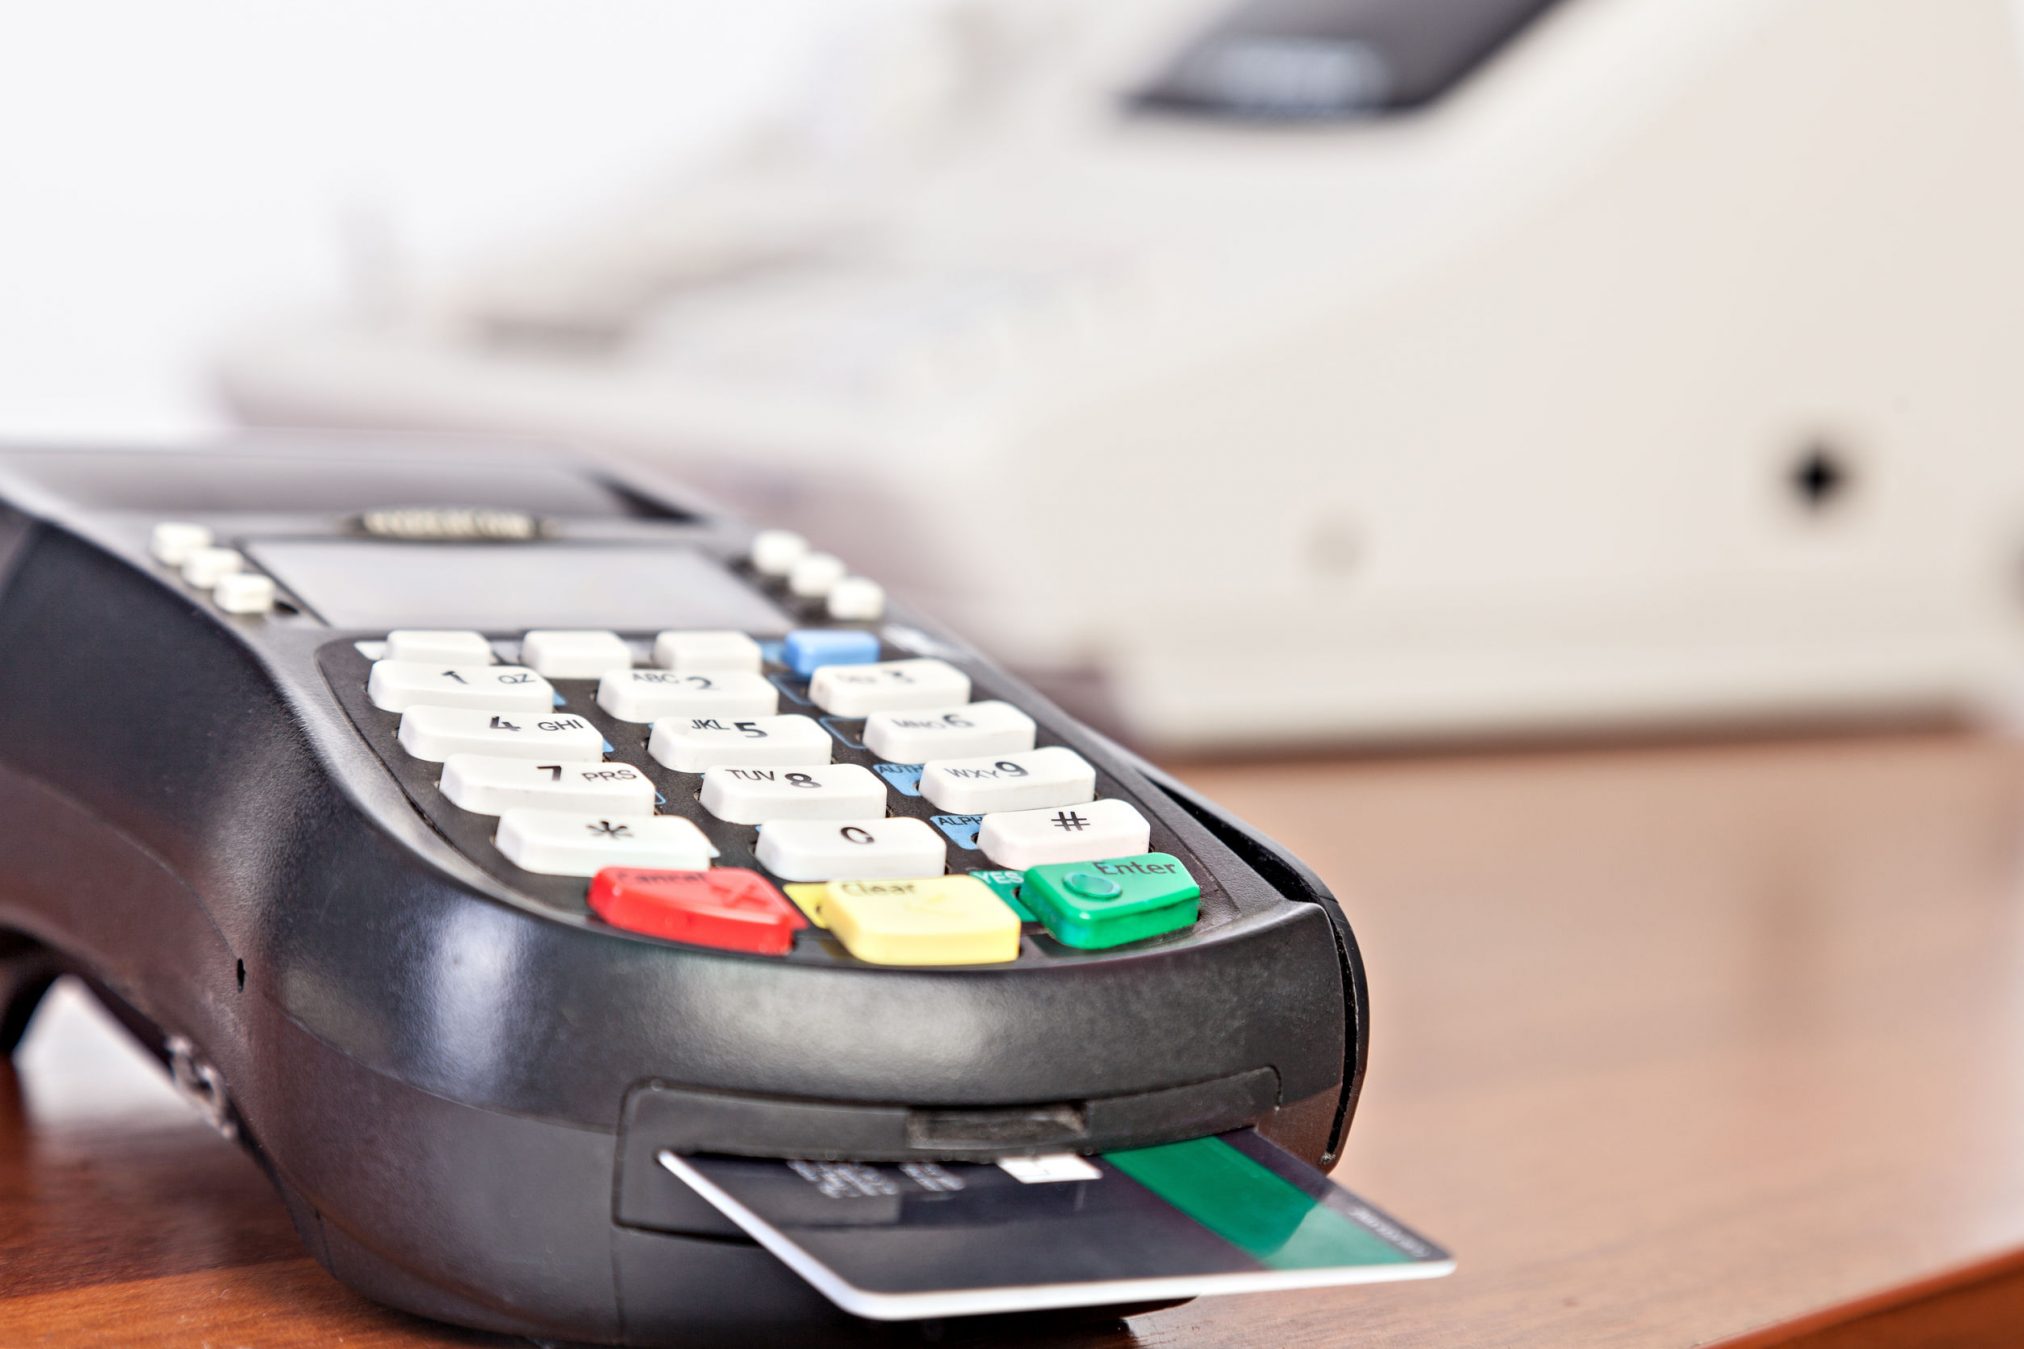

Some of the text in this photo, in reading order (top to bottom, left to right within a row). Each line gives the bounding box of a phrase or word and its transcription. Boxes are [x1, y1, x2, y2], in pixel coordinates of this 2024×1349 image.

[441, 670, 536, 685] 1 QZ
[687, 676, 720, 690] 2
[490, 716, 584, 732] 4 GHI
[691, 719, 768, 738] JKL 5
[942, 713, 976, 728] 6
[536, 765, 637, 783] 7 PRS
[944, 761, 1029, 779] WXY 9
[725, 769, 822, 789] TUV 8
[1092, 861, 1177, 875] Enter
[976, 871, 1024, 884] YES
[841, 880, 915, 896] Clear
